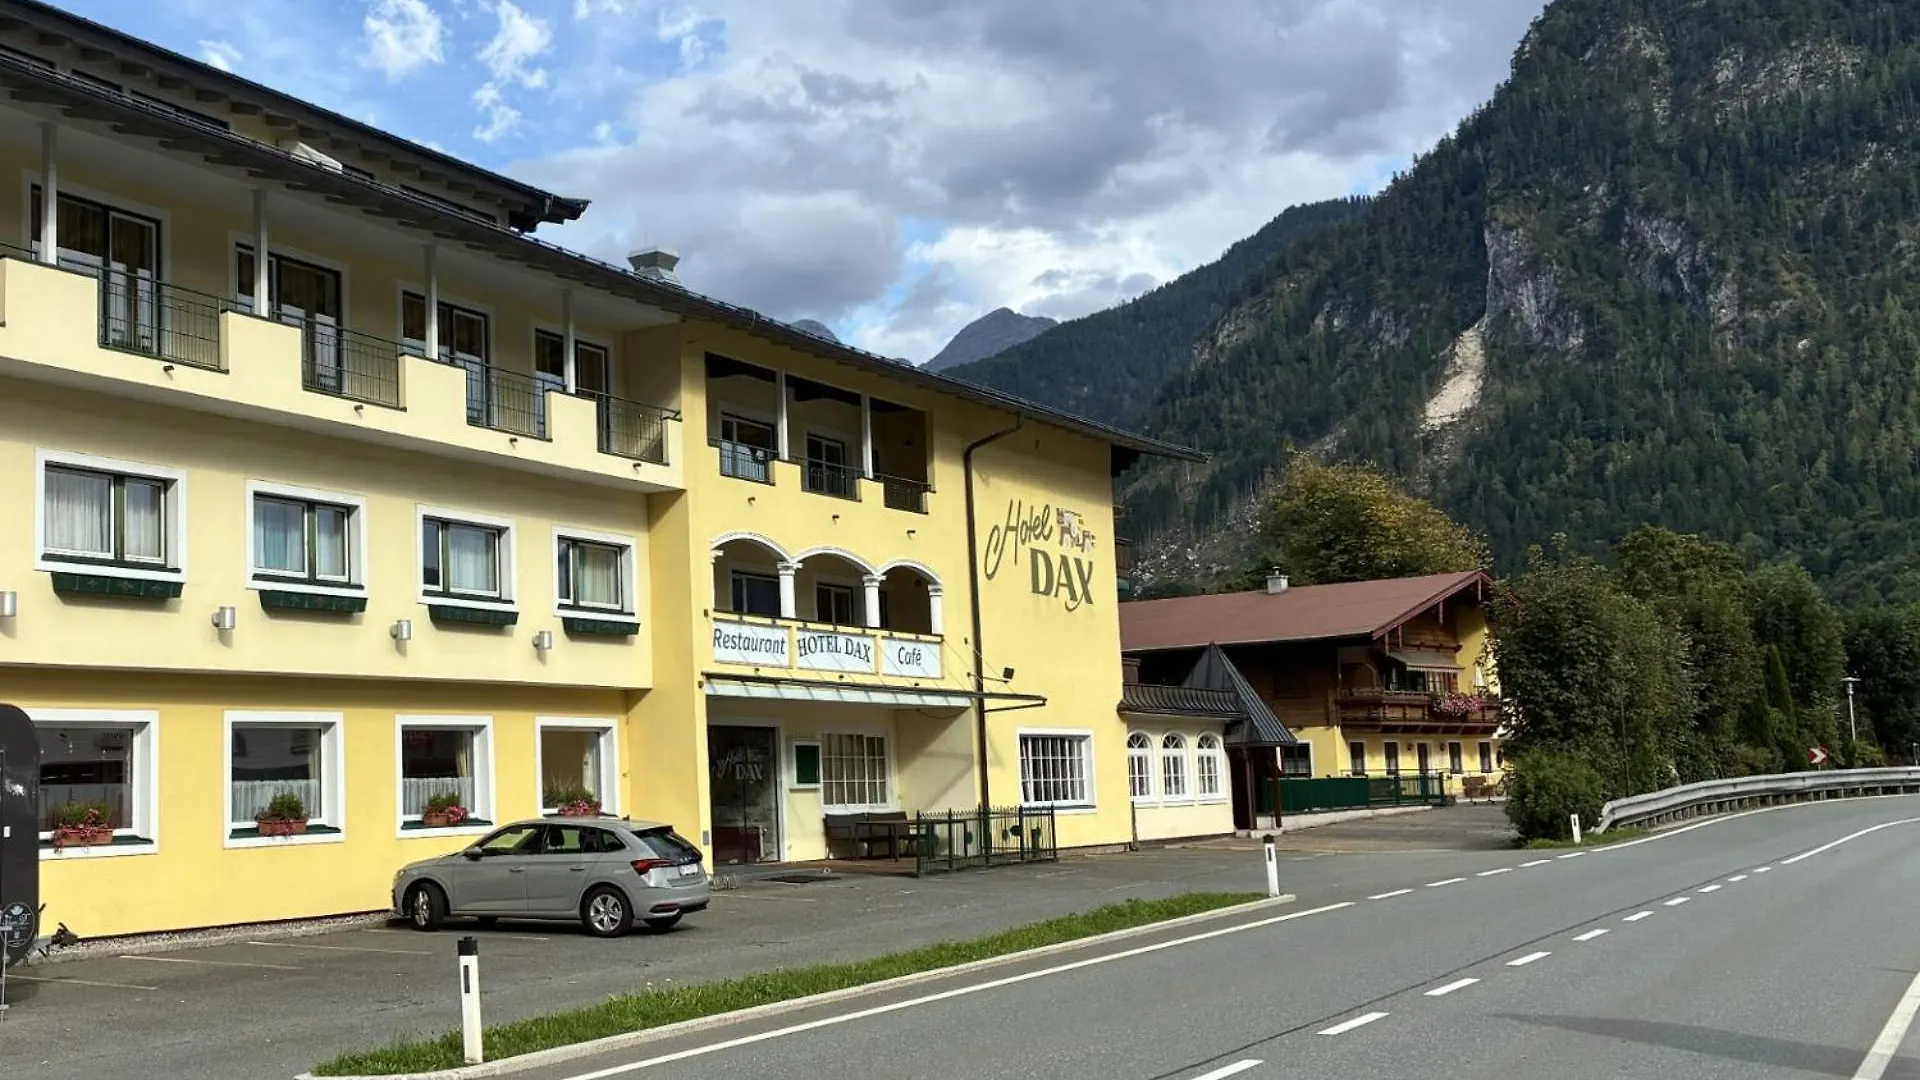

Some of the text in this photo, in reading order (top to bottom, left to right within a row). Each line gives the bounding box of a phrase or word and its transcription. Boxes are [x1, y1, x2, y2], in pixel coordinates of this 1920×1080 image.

[984, 499, 1053, 580] Hotel
[1030, 547, 1093, 612] DAX
[713, 628, 785, 655] Restaurant
[797, 635, 871, 663] HOTEL DAX
[898, 646, 922, 666] Café
